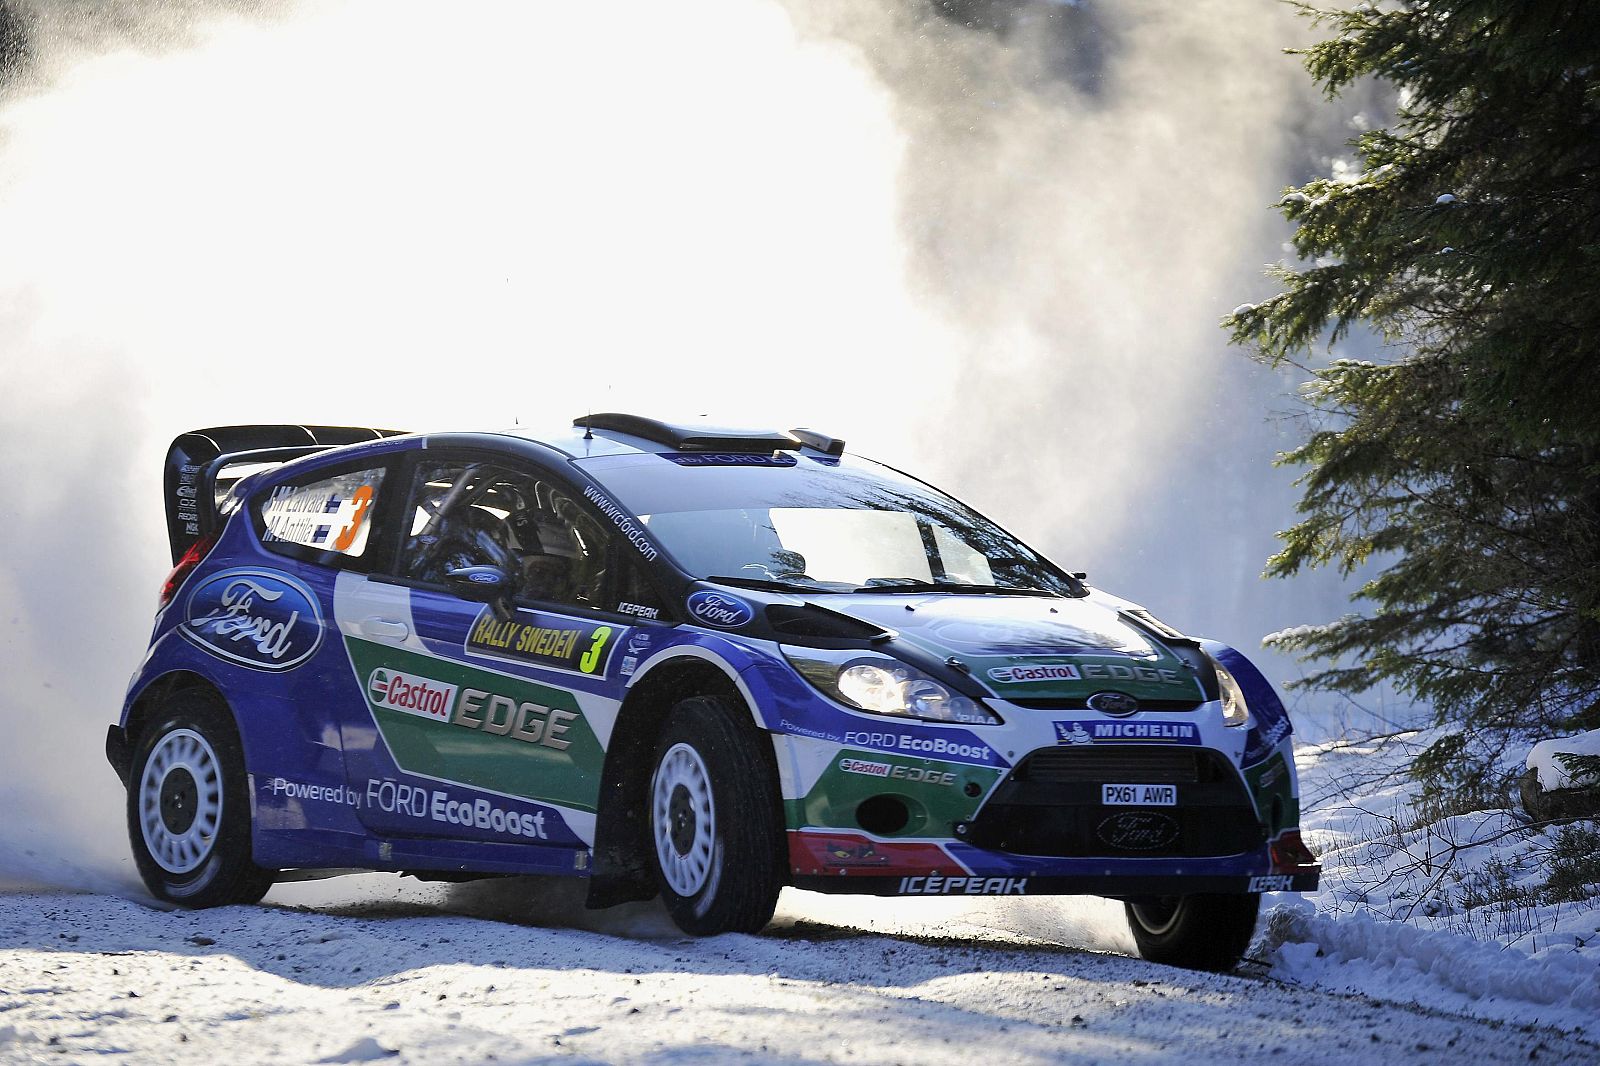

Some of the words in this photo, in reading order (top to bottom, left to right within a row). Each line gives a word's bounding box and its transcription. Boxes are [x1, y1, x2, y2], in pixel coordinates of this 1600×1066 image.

[335, 485, 374, 550] 3
[583, 485, 657, 561] www.wrcford.com
[191, 578, 299, 659] Ford
[617, 602, 659, 619] ICEPEAK
[696, 595, 743, 623] Ford
[472, 614, 521, 648] RALLY
[516, 626, 582, 659] SWEDEN
[579, 626, 612, 673] 3
[1012, 667, 1077, 680] Castrol
[1081, 664, 1184, 685] EDGE
[386, 676, 450, 717] Castrol
[453, 688, 580, 750] EDGE
[780, 719, 826, 739] Powered
[844, 731, 896, 747] FORD
[898, 736, 990, 760] EcoBoost
[1095, 724, 1193, 738] MICHELIN
[851, 762, 888, 775] Castrol
[891, 766, 957, 785] EDGE
[273, 777, 344, 804] Powered
[346, 786, 362, 809] by
[430, 792, 548, 840] EcoBoost
[1106, 787, 1137, 802] PX61
[1144, 787, 1174, 803] AWR
[899, 877, 1028, 894] ICEPEAK
